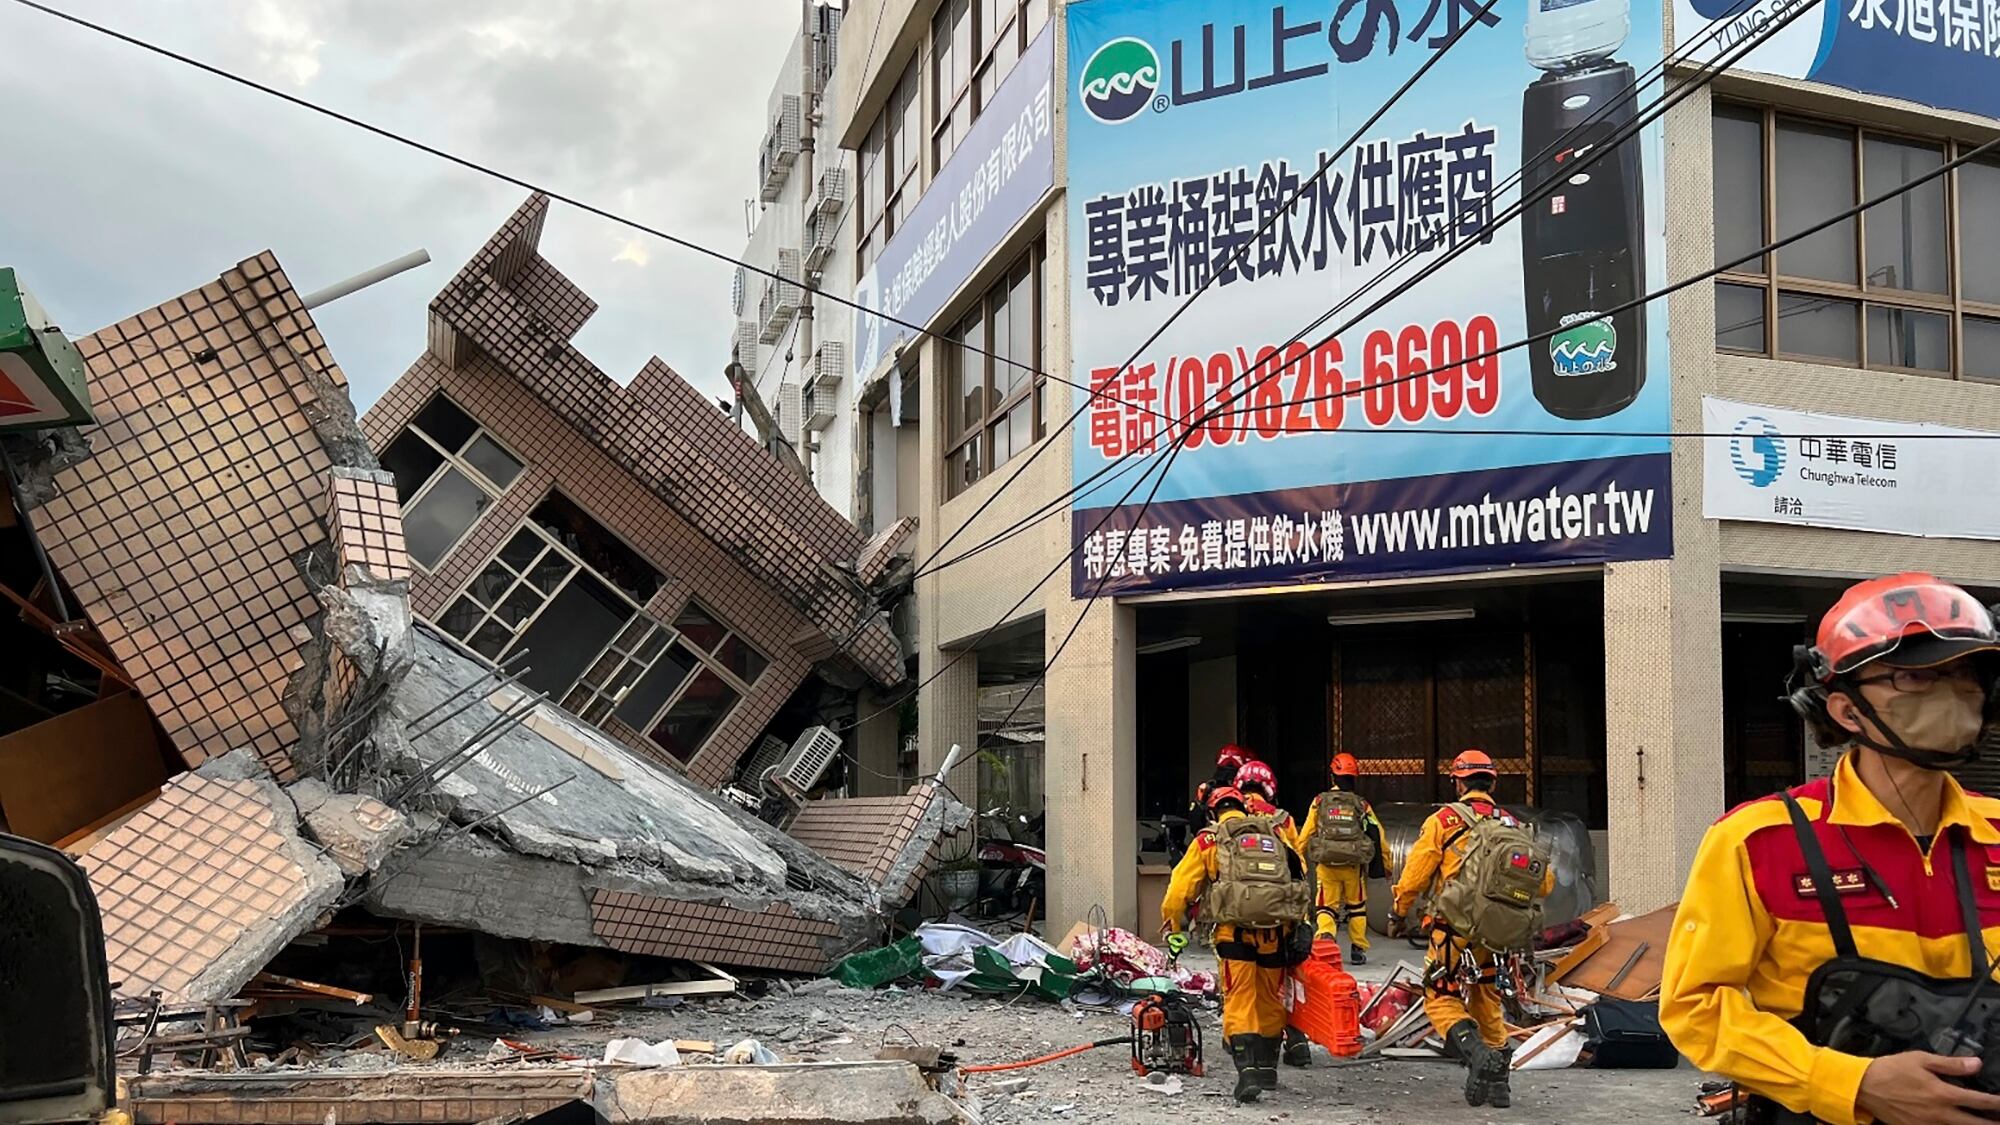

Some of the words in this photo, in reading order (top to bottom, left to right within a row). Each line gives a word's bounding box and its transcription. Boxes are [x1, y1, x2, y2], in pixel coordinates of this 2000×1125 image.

[1085, 122, 1496, 308] 專業桶裝飲水供應商
[1799, 436, 1897, 470] 中華電信
[1799, 467, 1854, 486] Chunghwa
[1855, 472, 1897, 489] Telecom
[1350, 480, 1655, 555] www.mtwater.tw
